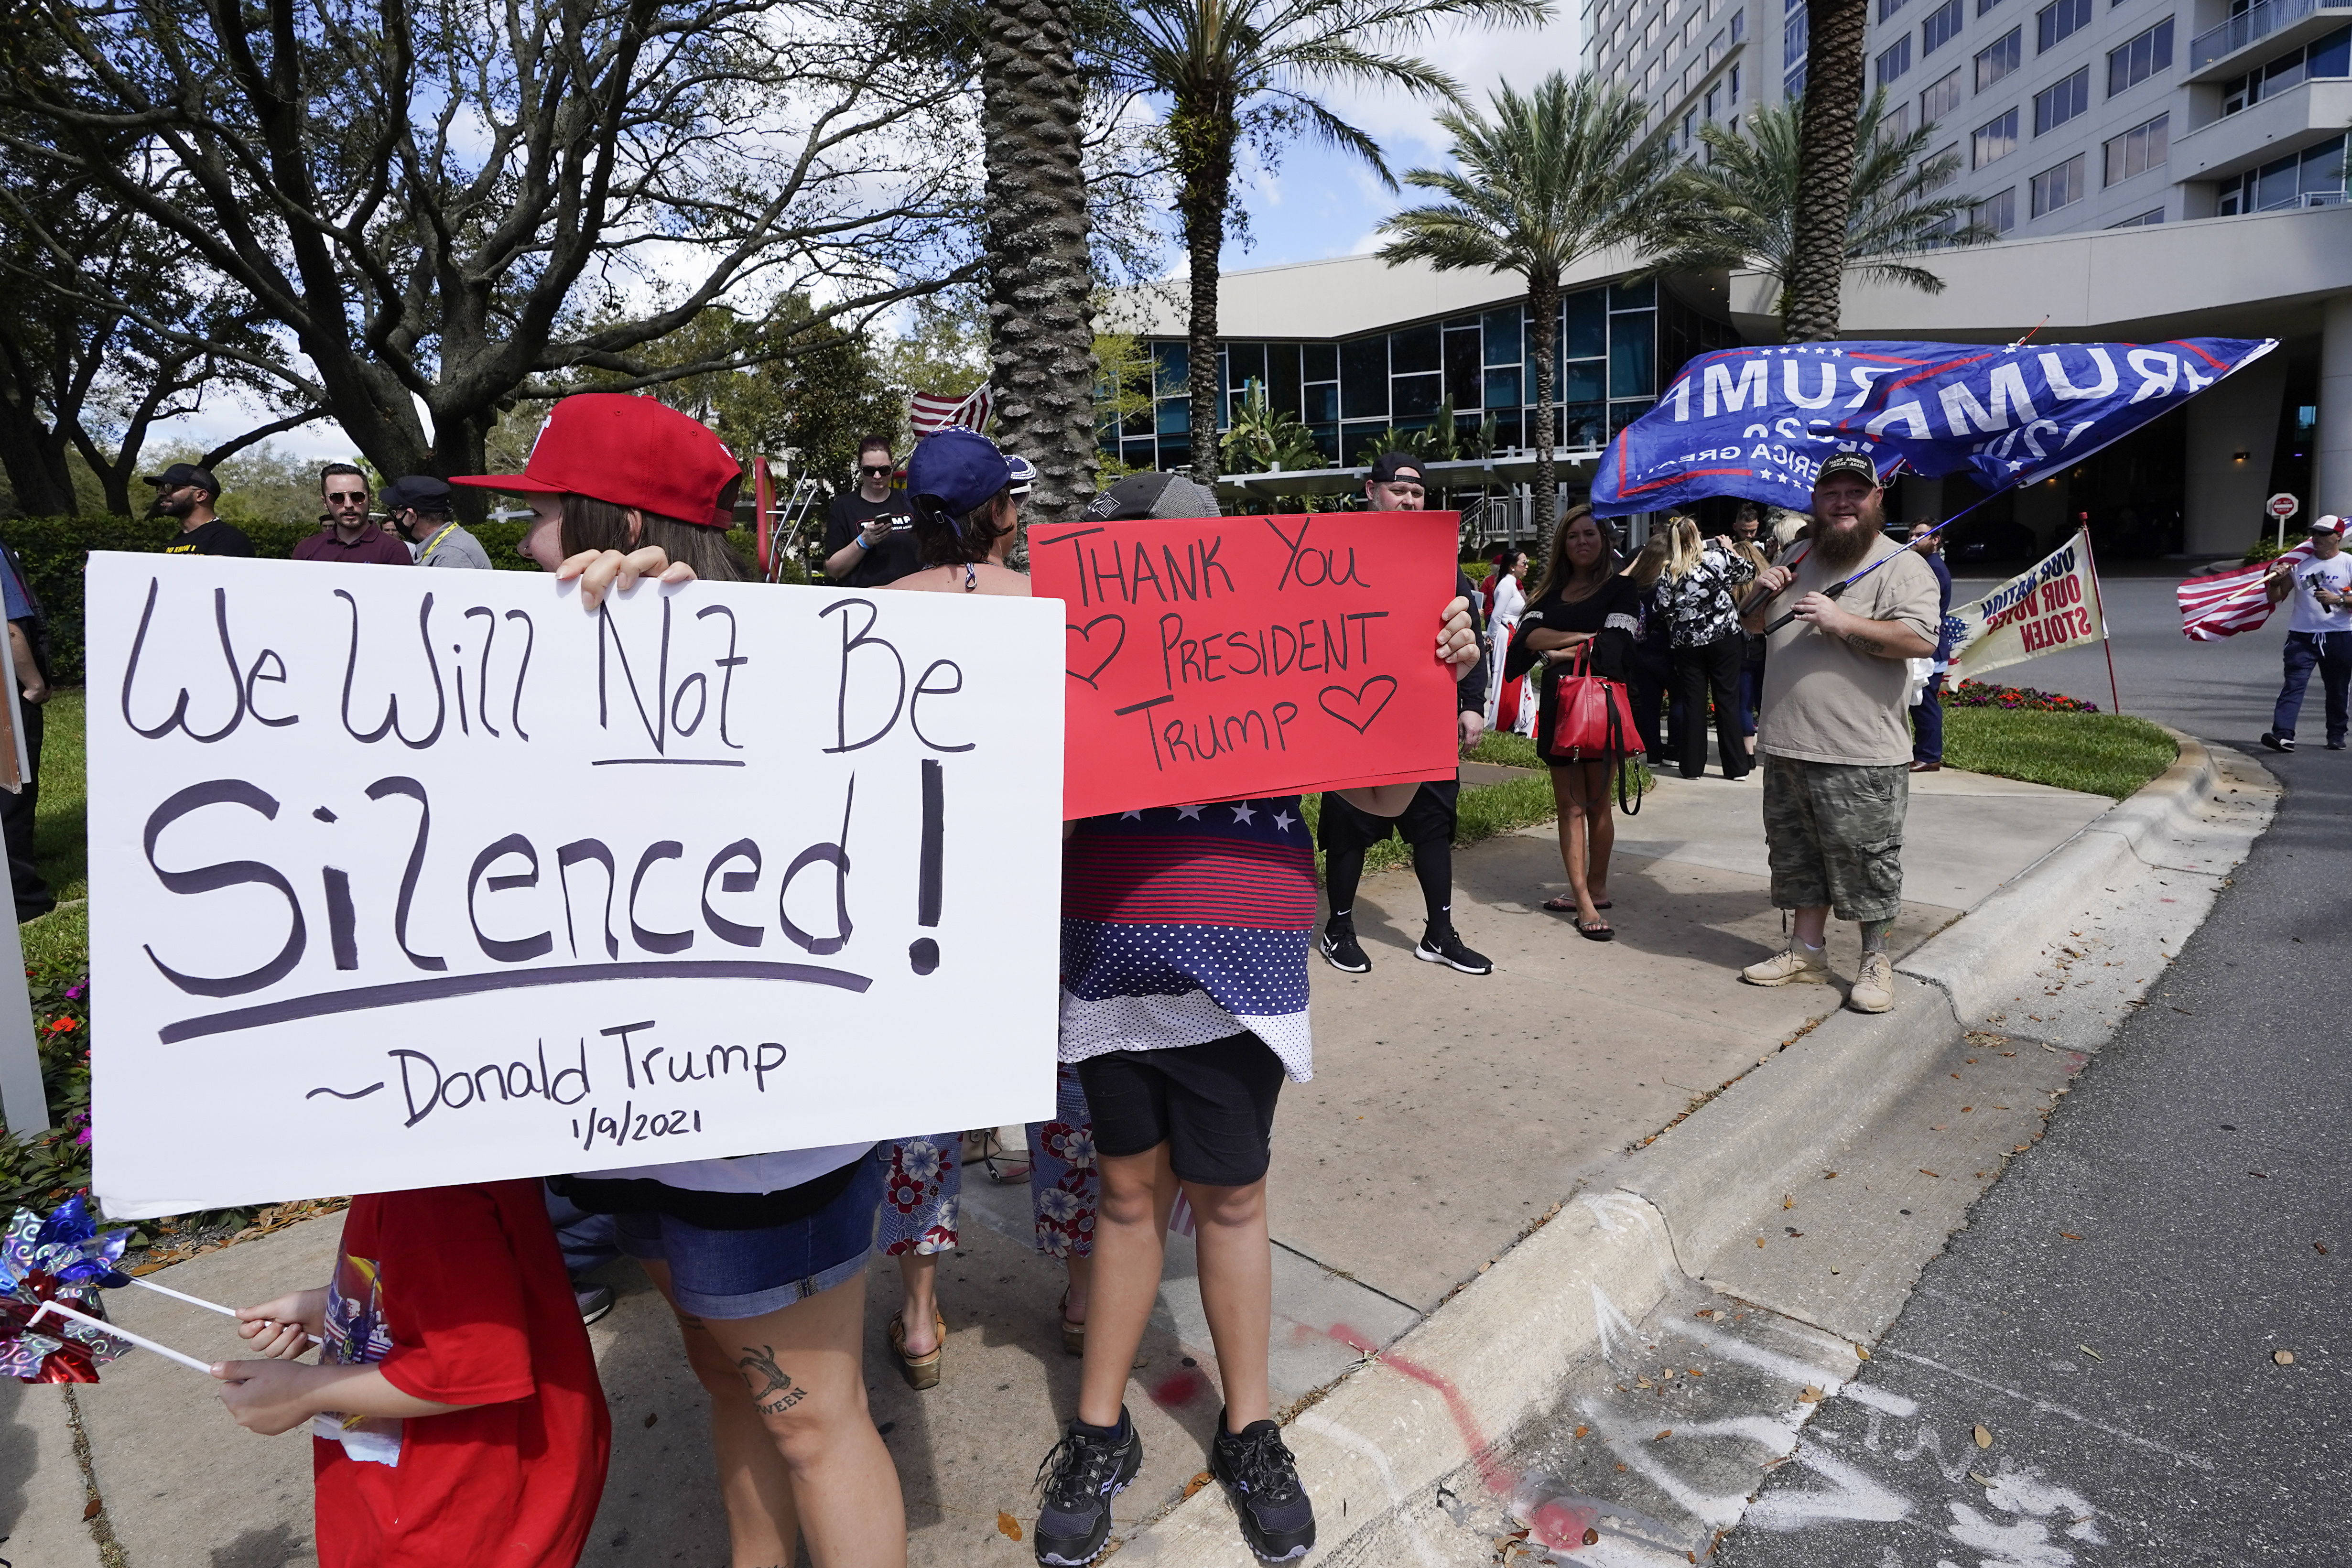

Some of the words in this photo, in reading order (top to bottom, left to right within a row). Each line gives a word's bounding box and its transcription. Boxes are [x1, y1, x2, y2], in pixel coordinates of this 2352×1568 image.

[1846, 457, 1867, 466] AMERICA
[1039, 527, 1235, 607] THANK
[122, 577, 299, 743] We
[334, 589, 533, 750] Will
[598, 596, 748, 757] Not
[819, 598, 976, 754] Be
[1159, 611, 1389, 690] PRESIDENT
[600, 1020, 786, 1092] Trump
[572, 1109, 701, 1151] 1/9/2021
